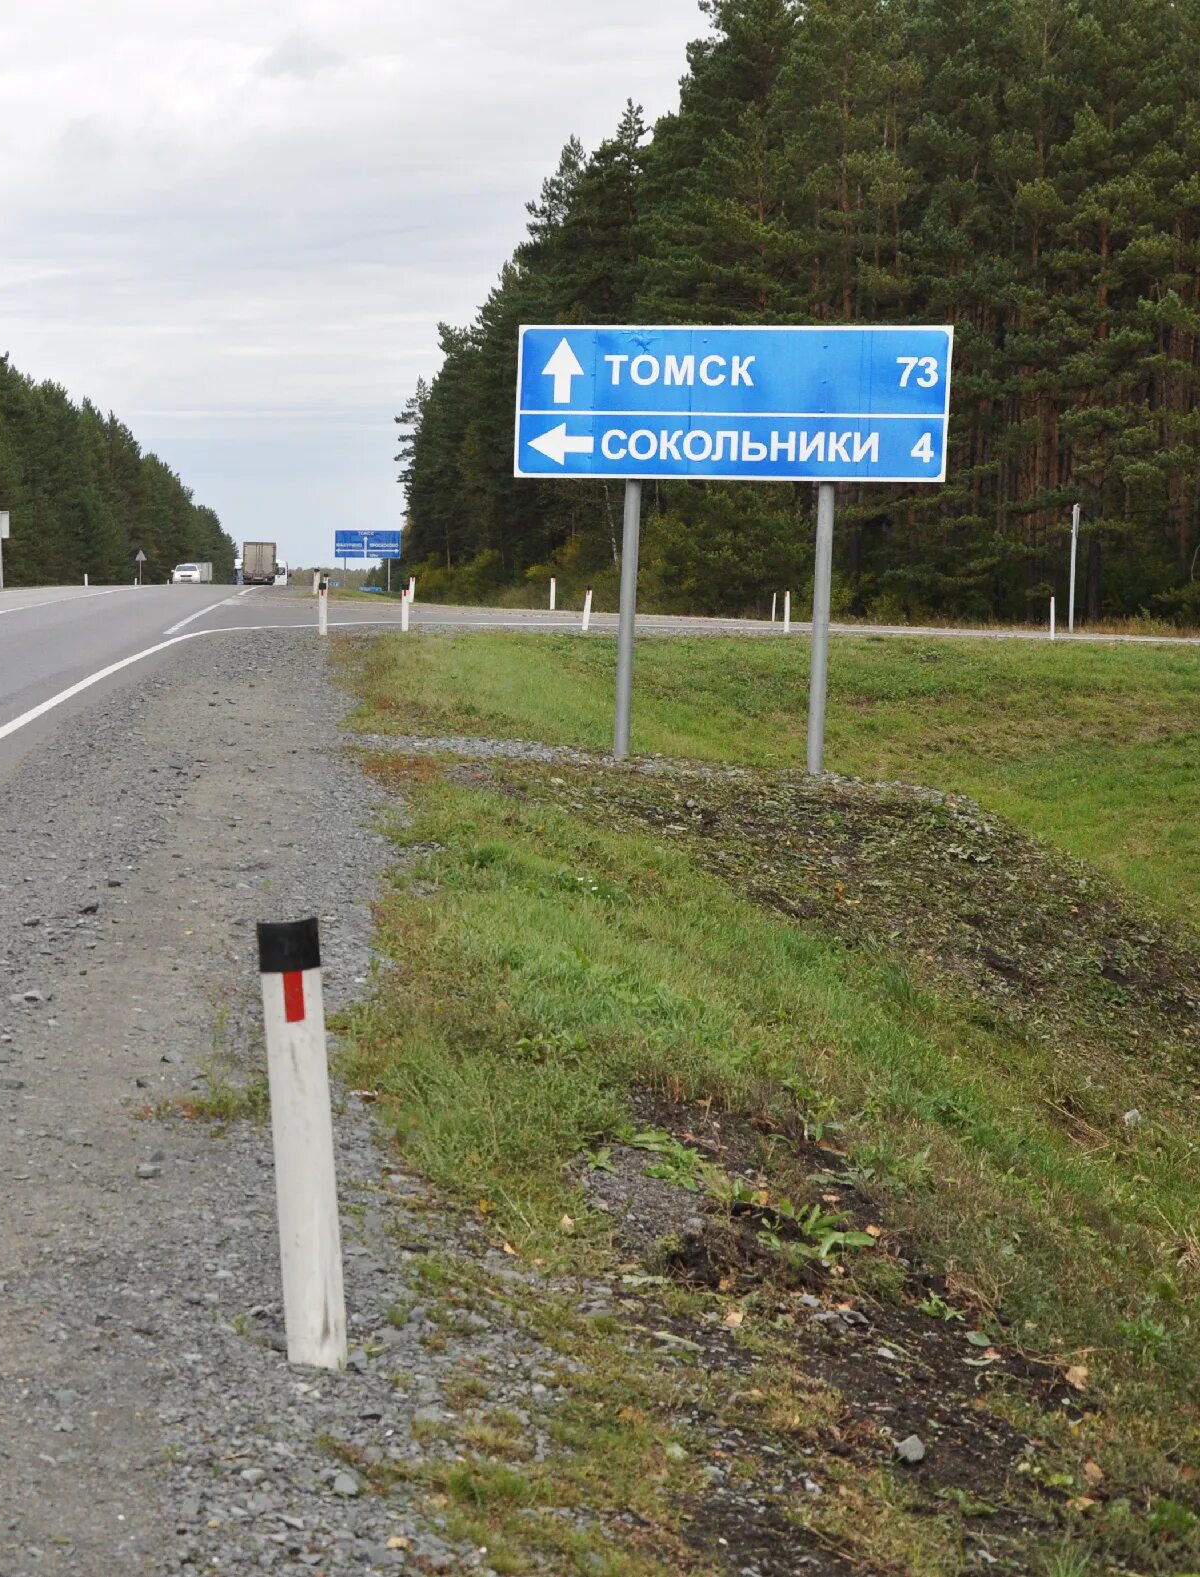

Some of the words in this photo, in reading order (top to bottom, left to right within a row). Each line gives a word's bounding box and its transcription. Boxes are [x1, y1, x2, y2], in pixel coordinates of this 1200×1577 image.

[604, 354, 756, 387] ТОМСК
[896, 356, 939, 388] 73
[601, 429, 880, 463] СОКОЛЬНИКИ
[910, 432, 935, 464] 4
